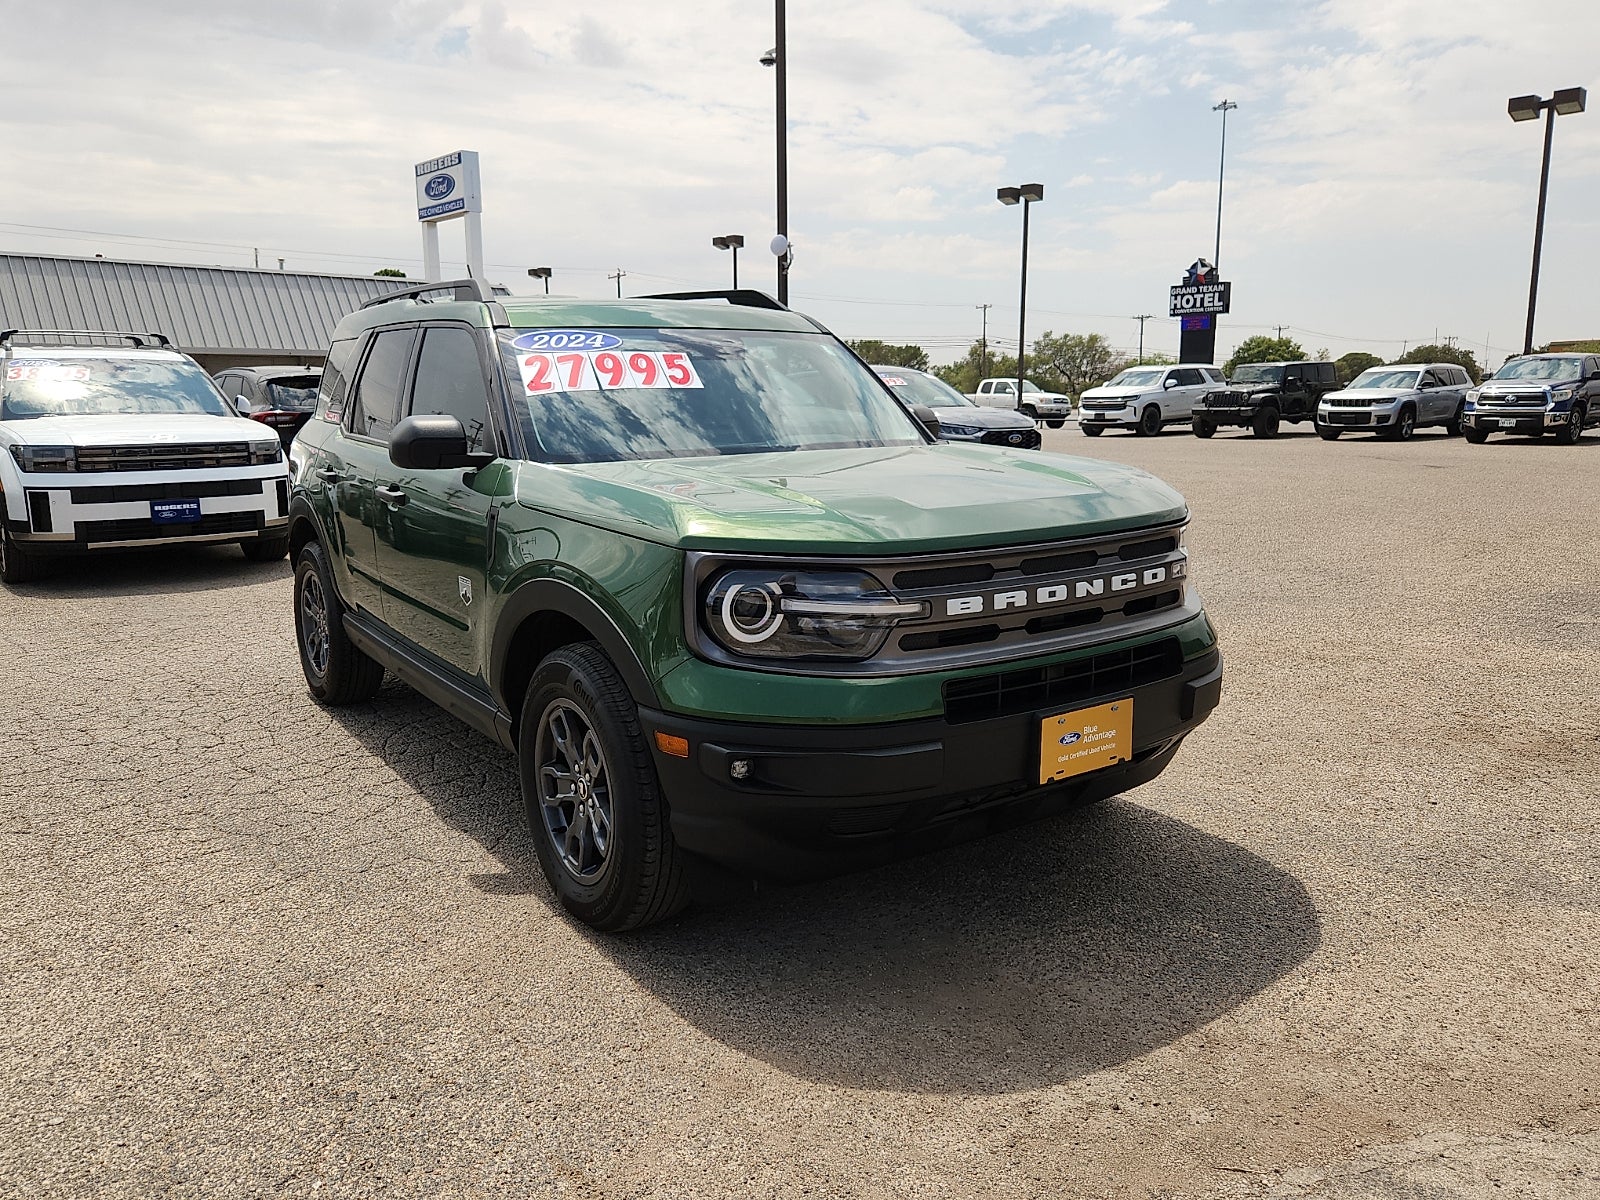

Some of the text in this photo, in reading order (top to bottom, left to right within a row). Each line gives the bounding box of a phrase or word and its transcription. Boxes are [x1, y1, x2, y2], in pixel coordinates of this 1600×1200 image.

[416, 153, 459, 175] ROGERS
[430, 178, 448, 195] Ford
[420, 200, 463, 217] PRE-OWNED VEHICLES
[1171, 284, 1224, 295] GRAND TEXAN
[1170, 292, 1223, 309] HOTEL
[530, 334, 605, 349] 2024
[524, 353, 692, 391] 27995
[946, 567, 1166, 615] BRONCO
[1083, 725, 1098, 734] Blue
[1083, 729, 1116, 743] Advantage
[1069, 749, 1088, 759] Certified
[1088, 746, 1100, 754] Used
[1100, 742, 1116, 750] Vehicle
